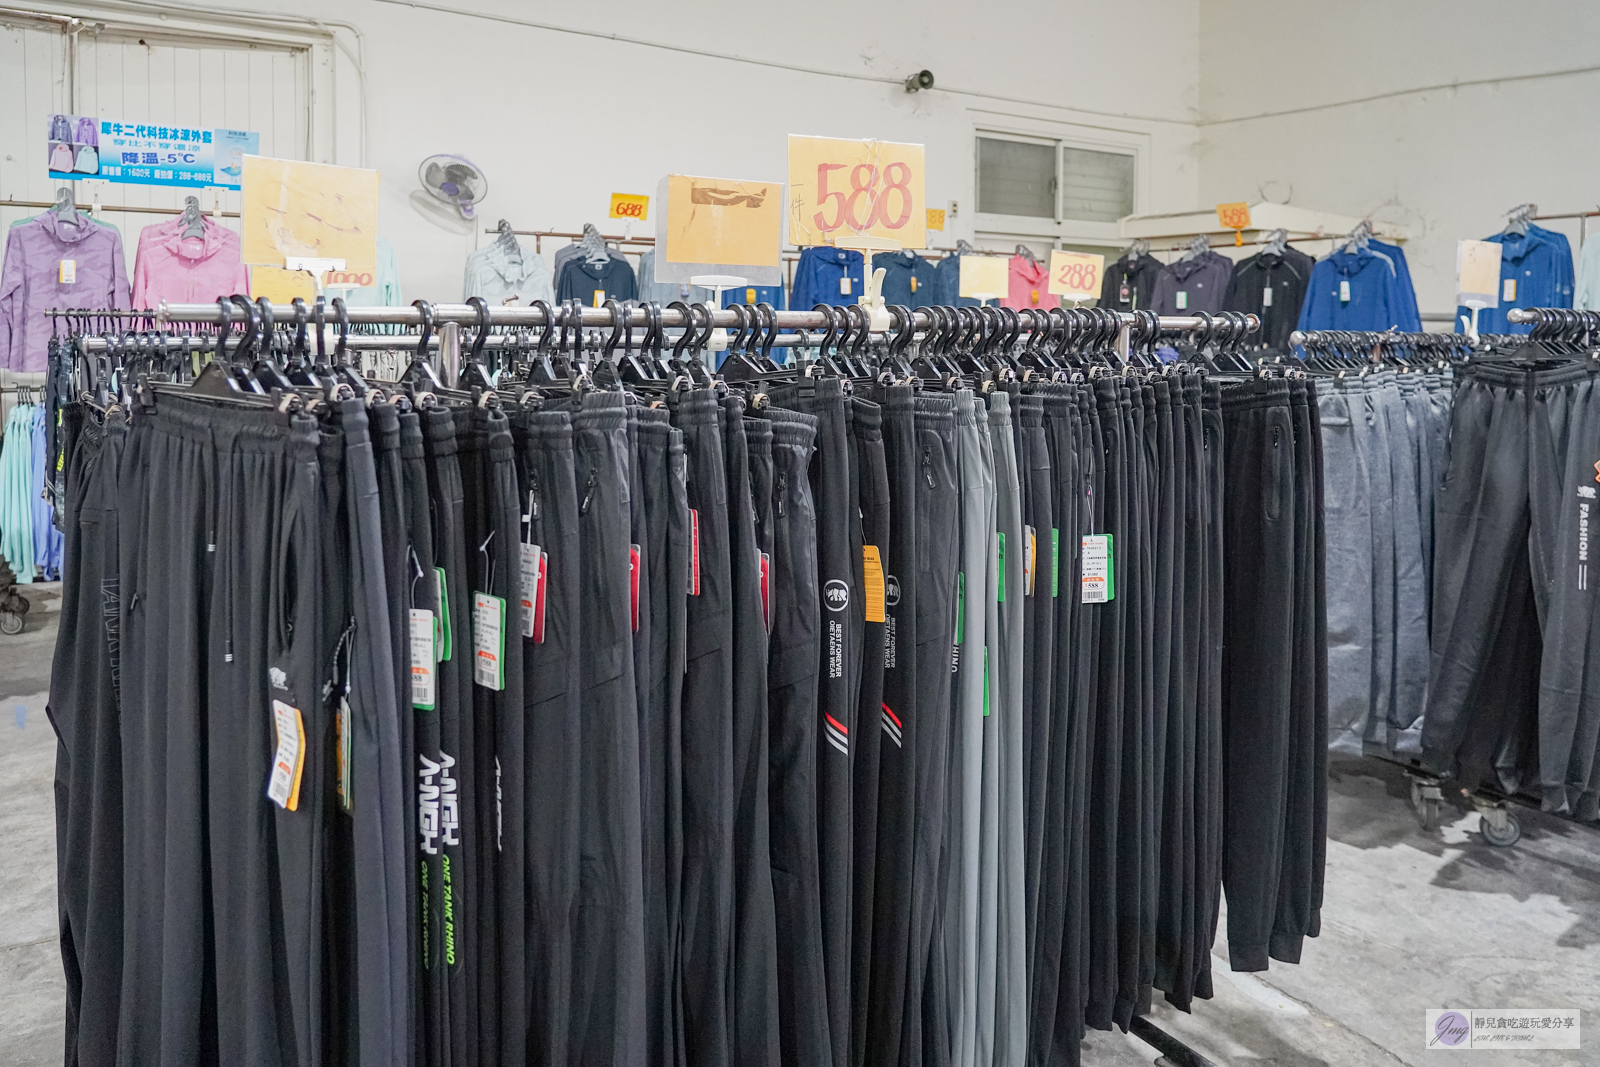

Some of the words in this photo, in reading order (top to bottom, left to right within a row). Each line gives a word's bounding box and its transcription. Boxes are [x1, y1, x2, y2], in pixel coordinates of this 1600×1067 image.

[615, 202, 643, 217] 688
[813, 162, 913, 233] 588
[926, 209, 945, 224] 88
[1057, 263, 1097, 291] 288
[1579, 503, 1589, 561] FASHION
[442, 854, 450, 882] ONE
[444, 884, 453, 919] TANK
[446, 919, 455, 965] RHINO
